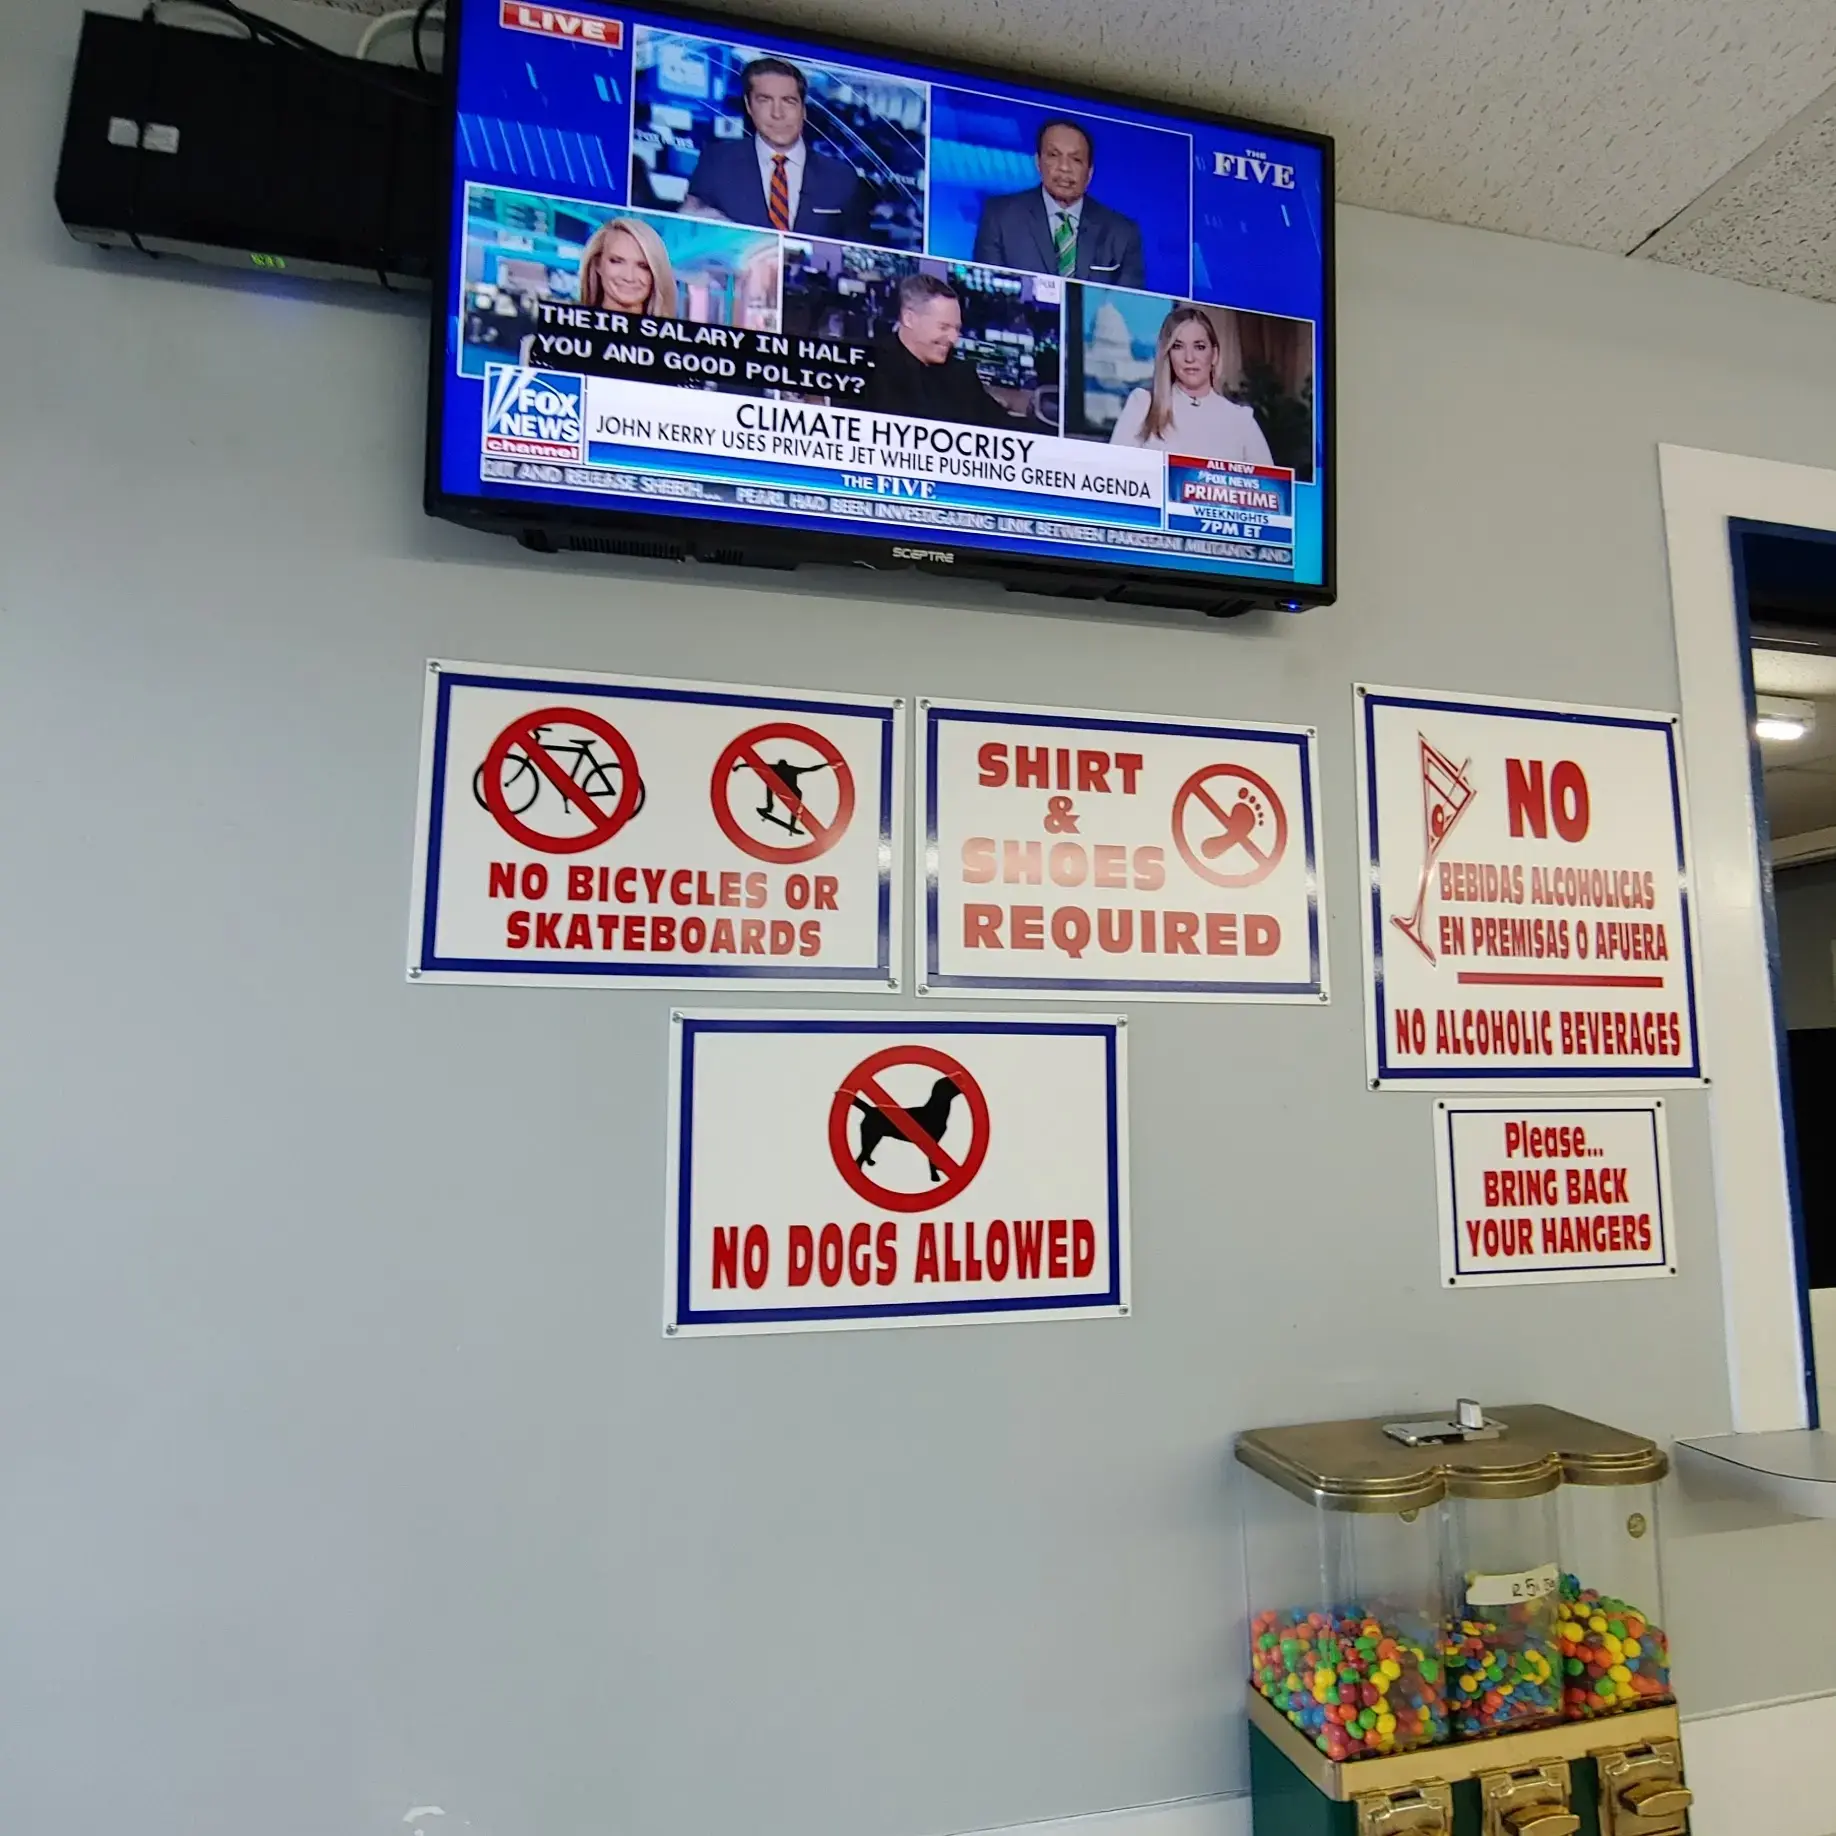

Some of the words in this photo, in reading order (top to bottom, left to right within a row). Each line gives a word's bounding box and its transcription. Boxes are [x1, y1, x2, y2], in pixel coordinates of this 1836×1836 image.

[518, 7, 607, 41] LIVE
[1213, 151, 1295, 190] FIVE
[540, 303, 628, 334] THEIR
[641, 319, 744, 350] SALARY
[756, 334, 788, 356] IN
[799, 340, 876, 368] HALF.
[538, 334, 592, 358] YOU
[603, 342, 654, 367] AND
[664, 349, 735, 377] GOOD
[746, 362, 866, 395] POLICY?
[518, 388, 579, 419] FOX
[500, 412, 580, 442] NEWS
[737, 403, 860, 442] CLIMATE
[872, 420, 1034, 464] HYPOCRISY
[487, 440, 578, 460] channel
[596, 415, 651, 440] JOHN
[659, 422, 715, 448] KERRY
[722, 430, 766, 454] USES
[772, 437, 843, 464] PRIVATE
[848, 446, 876, 466] JET
[880, 448, 934, 473] WHILE
[939, 457, 1016, 483] PUSHING
[1023, 467, 1077, 491] GREEN
[1081, 474, 1151, 499] AGENDA
[1207, 460, 1226, 471] ALL
[1228, 463, 1255, 475] NEW
[841, 474, 873, 489] THE
[877, 475, 937, 500] FIVE
[1184, 483, 1278, 509] PRIMETIME
[1205, 472, 1228, 486] FOX
[1229, 476, 1260, 489] NEWS
[517, 463, 562, 483] AND
[736, 487, 785, 508] PEARL
[789, 493, 828, 512] HAD
[830, 497, 873, 517] BEEN
[998, 516, 1035, 535] LINK
[1035, 521, 1106, 542] BETWEEN
[1258, 547, 1291, 563] AND
[1193, 506, 1269, 524] WEEKNIGHTS
[1201, 519, 1239, 536] 7PM
[1243, 525, 1263, 539] ET
[892, 547, 954, 564] SCEPTRE
[978, 742, 1143, 795] SHIRT
[1044, 796, 1080, 834] &
[1505, 758, 1589, 843] NO
[961, 837, 1166, 891] SHOES
[489, 862, 547, 900] NO
[568, 864, 768, 909] BICYCLES
[785, 874, 839, 911] OR
[1439, 862, 1524, 905] BEBIDAS
[1531, 866, 1655, 910] ALCOHOLICAS
[507, 911, 821, 957] SKATEBOARDS
[964, 903, 1281, 959] REQUIRED
[1439, 916, 1465, 956] EN
[1471, 917, 1570, 960] PREMISAS
[1576, 920, 1589, 960] O
[1595, 922, 1669, 961] AFUERA
[1395, 1008, 1426, 1055] NO
[1436, 1010, 1552, 1056] ALCOHOLIC
[1560, 1011, 1680, 1056] BEVERAGES
[1504, 1121, 1603, 1158] Please...
[1483, 1169, 1558, 1207] BRING
[1565, 1168, 1630, 1205] BACK
[712, 1223, 769, 1290] NO
[787, 1222, 897, 1288] DOGS
[915, 1219, 1095, 1283] ALLOWED
[1466, 1218, 1534, 1257] YOUR
[1541, 1214, 1651, 1254] HANGERS
